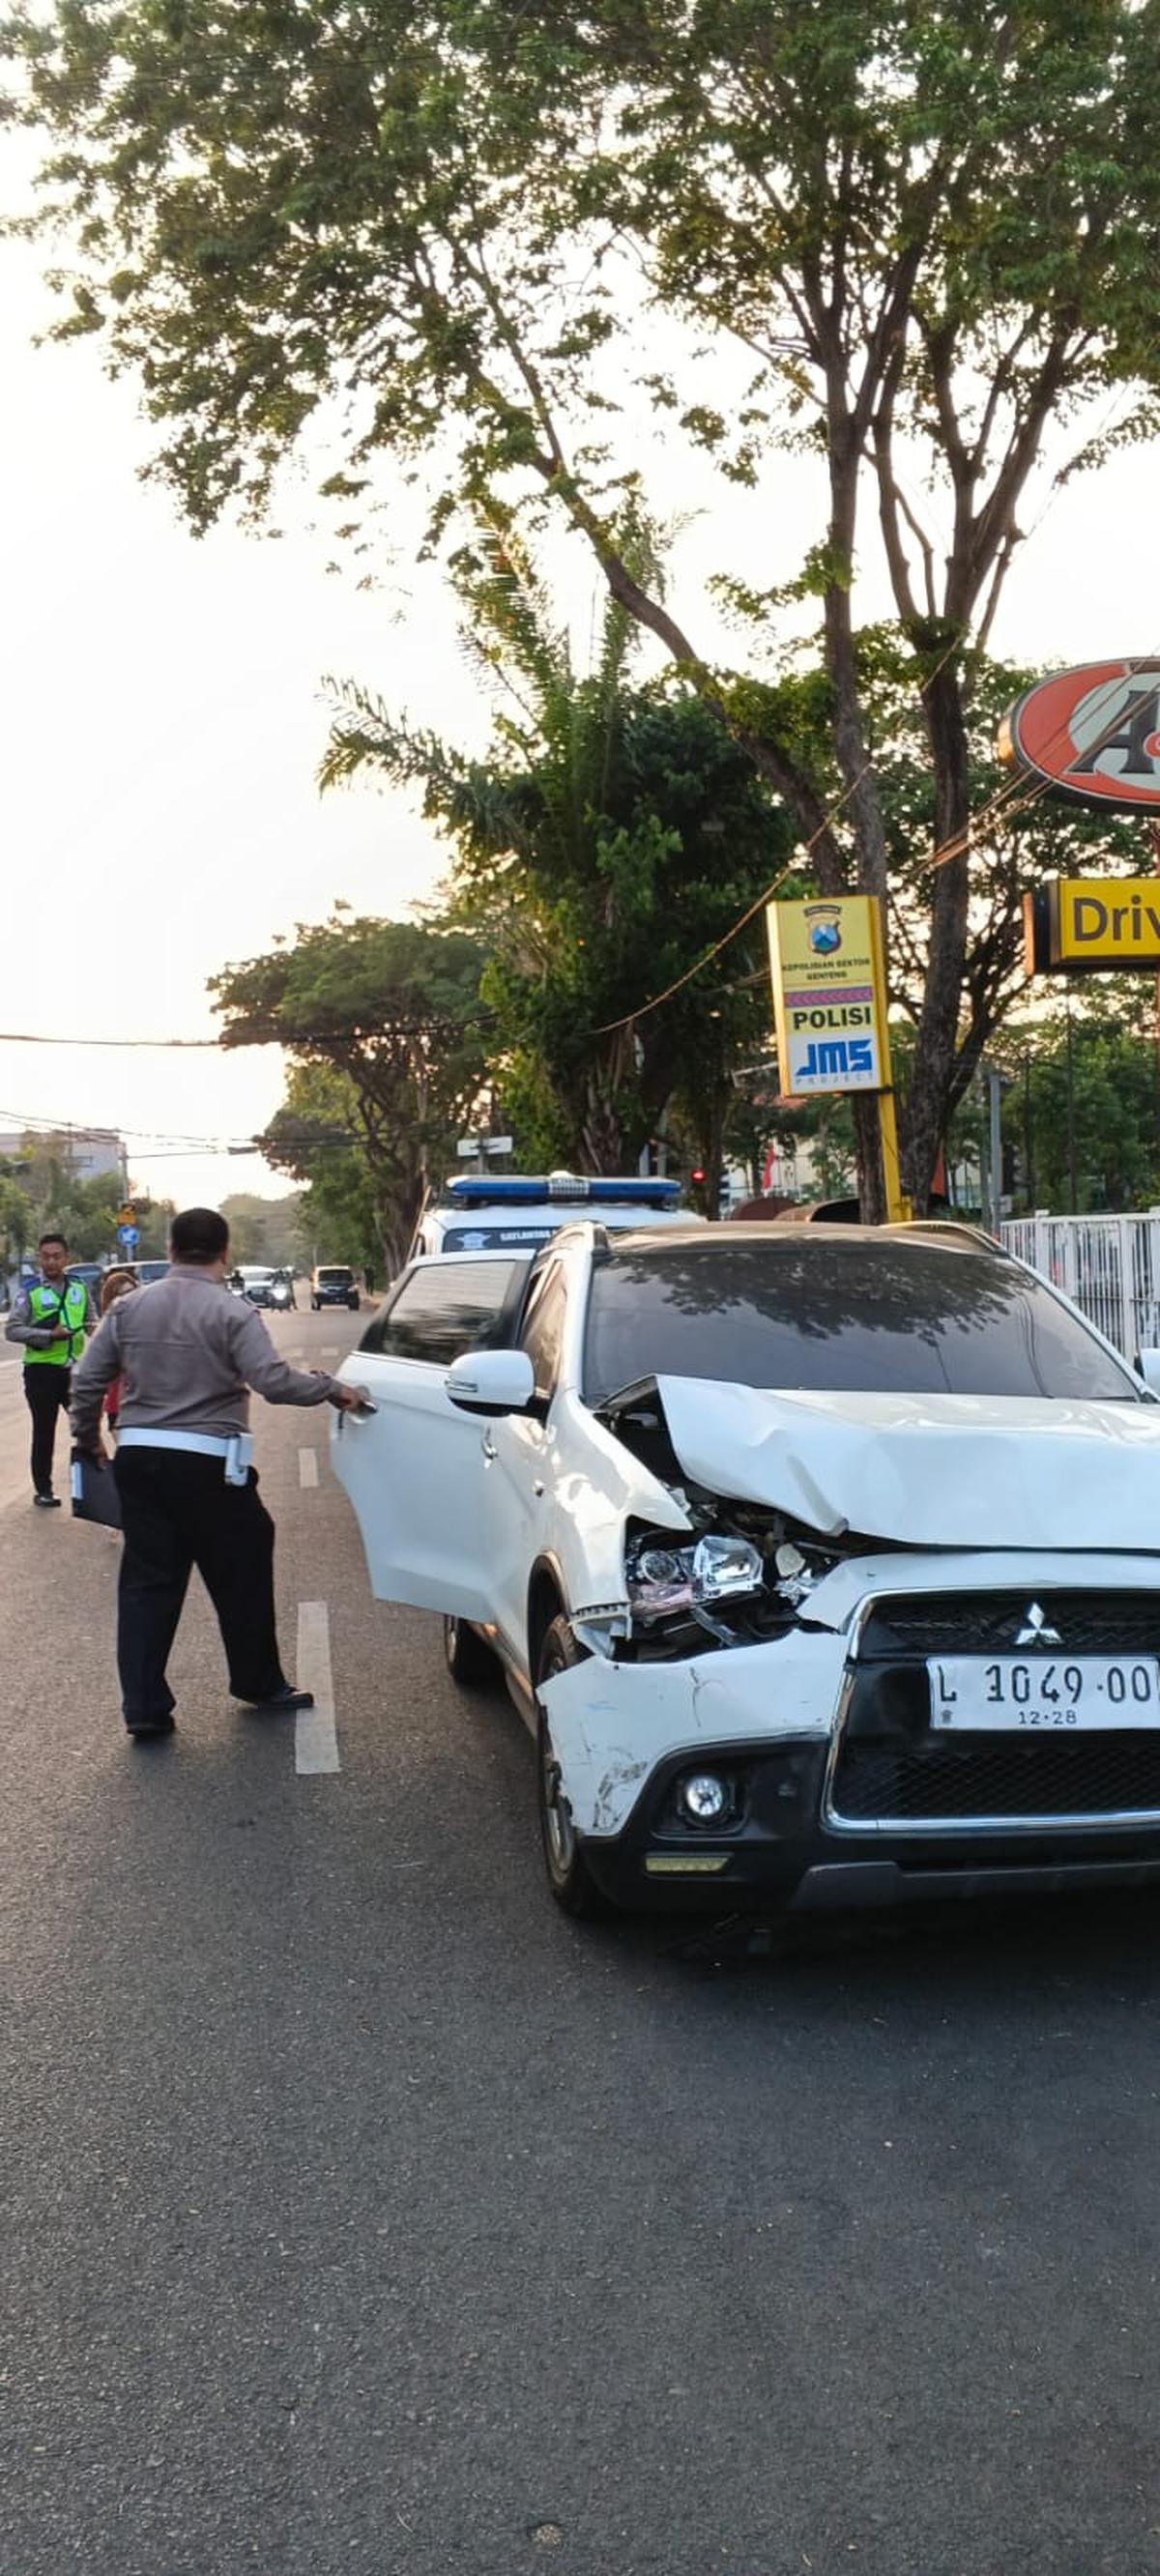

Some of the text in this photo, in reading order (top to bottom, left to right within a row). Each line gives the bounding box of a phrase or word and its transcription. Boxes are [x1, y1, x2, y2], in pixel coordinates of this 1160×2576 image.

[793, 1007, 872, 1029] POLISI
[795, 1039, 873, 1076] JMS
[937, 1664, 958, 1702] L
[984, 1664, 1084, 1704] 1049
